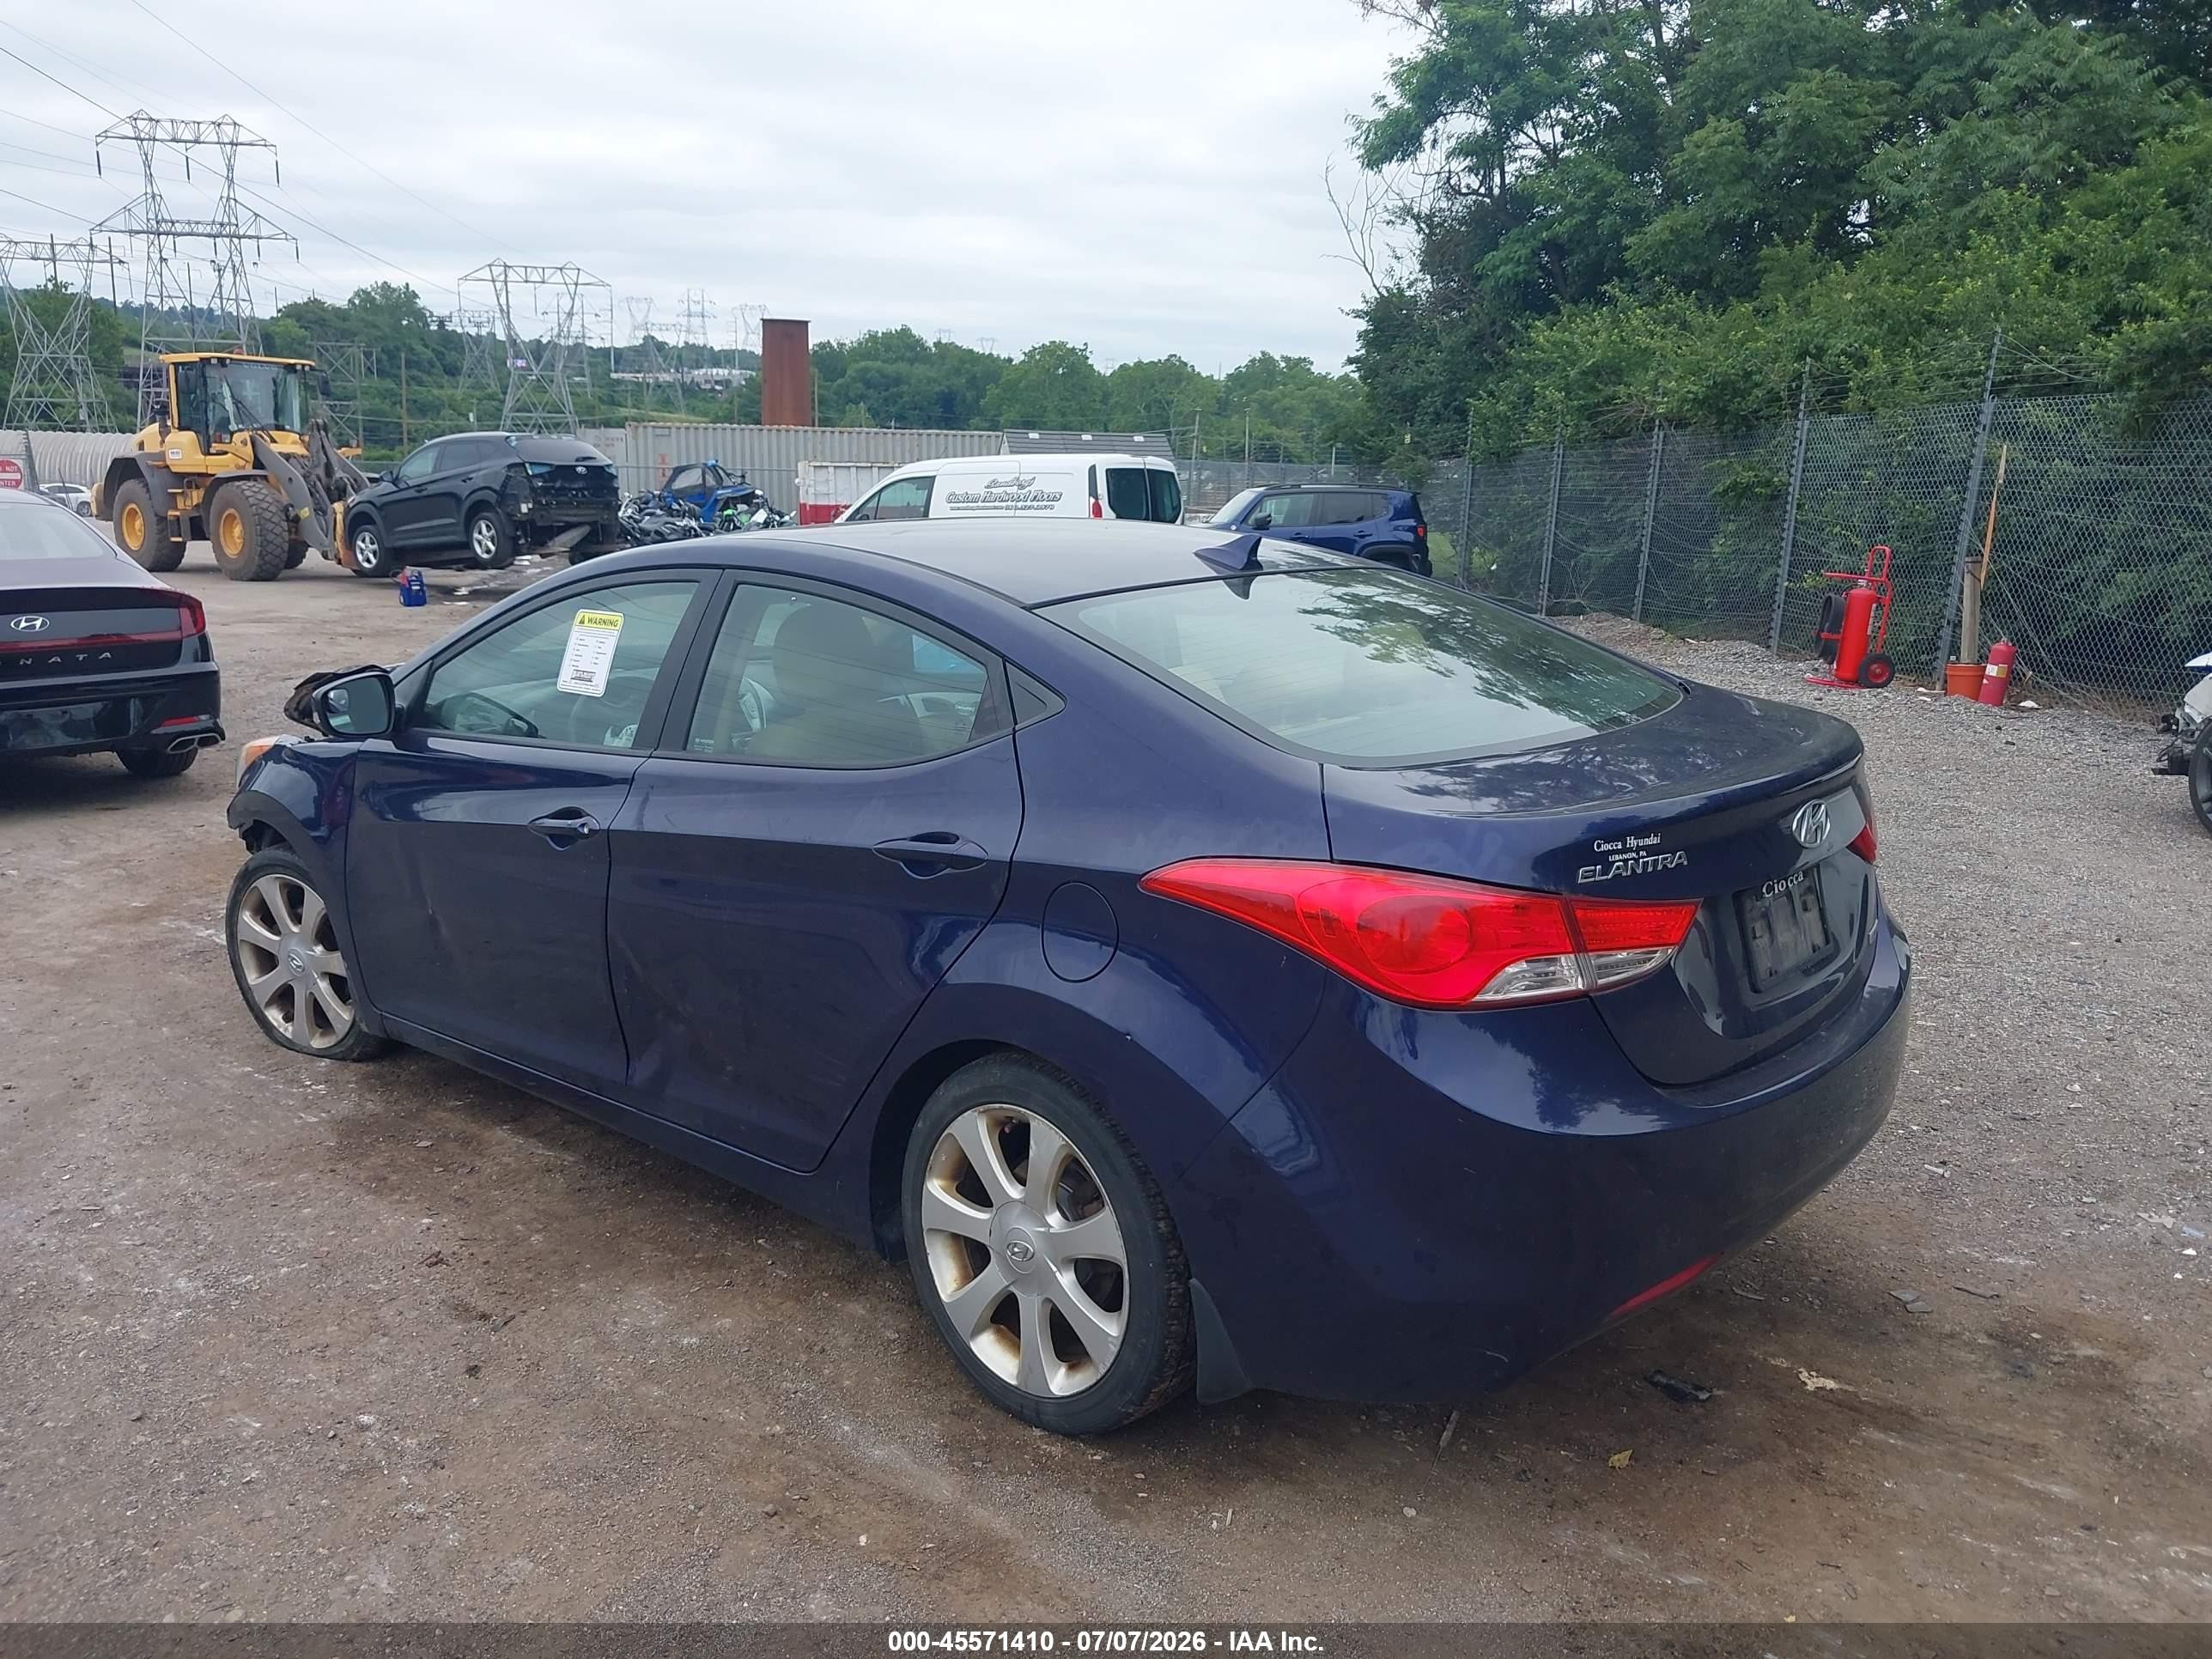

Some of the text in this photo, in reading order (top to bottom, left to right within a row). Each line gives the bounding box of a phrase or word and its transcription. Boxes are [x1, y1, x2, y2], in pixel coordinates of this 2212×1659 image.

[945, 489, 1063, 503] Custom Hardwood Floors
[587, 616, 619, 628] WARNING
[0, 652, 112, 665] NATA
[1594, 833, 1662, 852] Ciocca Hyundai
[1608, 852, 1638, 861] LEBANON,
[1577, 851, 1688, 884] ELANTRA
[1762, 870, 1804, 897] Ciocca
